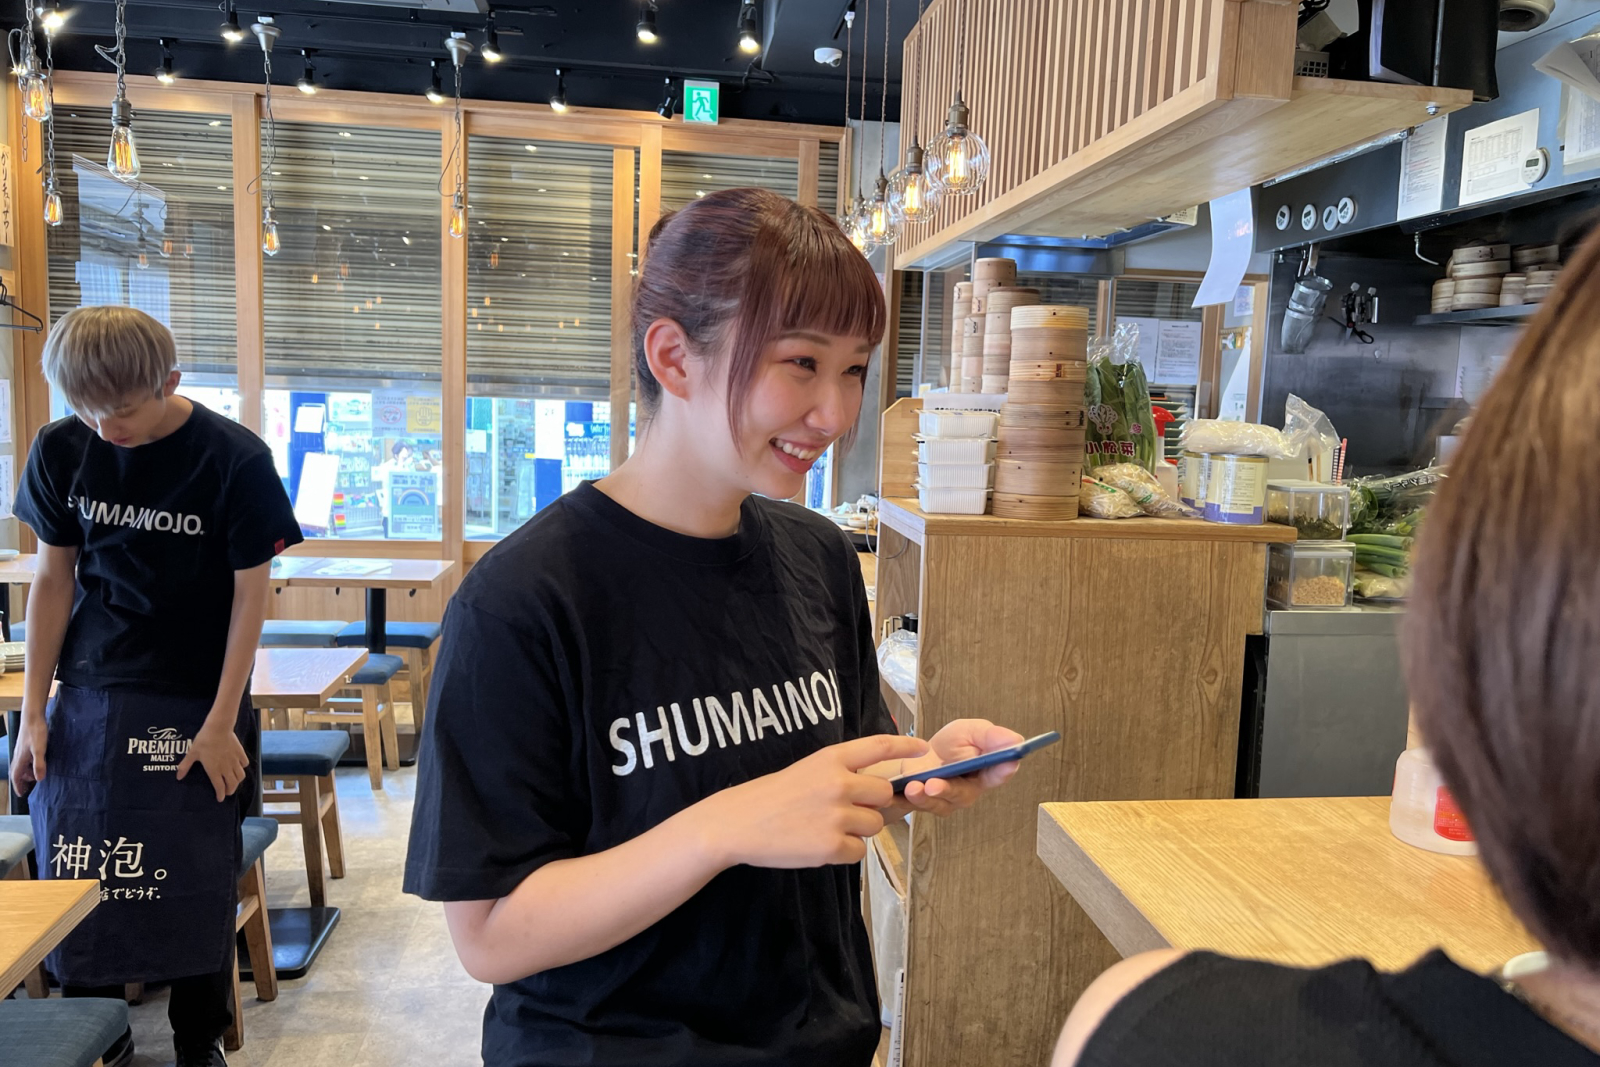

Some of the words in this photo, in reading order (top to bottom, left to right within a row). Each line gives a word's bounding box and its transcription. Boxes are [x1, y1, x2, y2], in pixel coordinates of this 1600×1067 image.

[1085, 440, 1136, 457] 小松菜
[67, 495, 205, 535] UMAINOJO.
[147, 726, 182, 740] The
[50, 834, 167, 880] 神泡。
